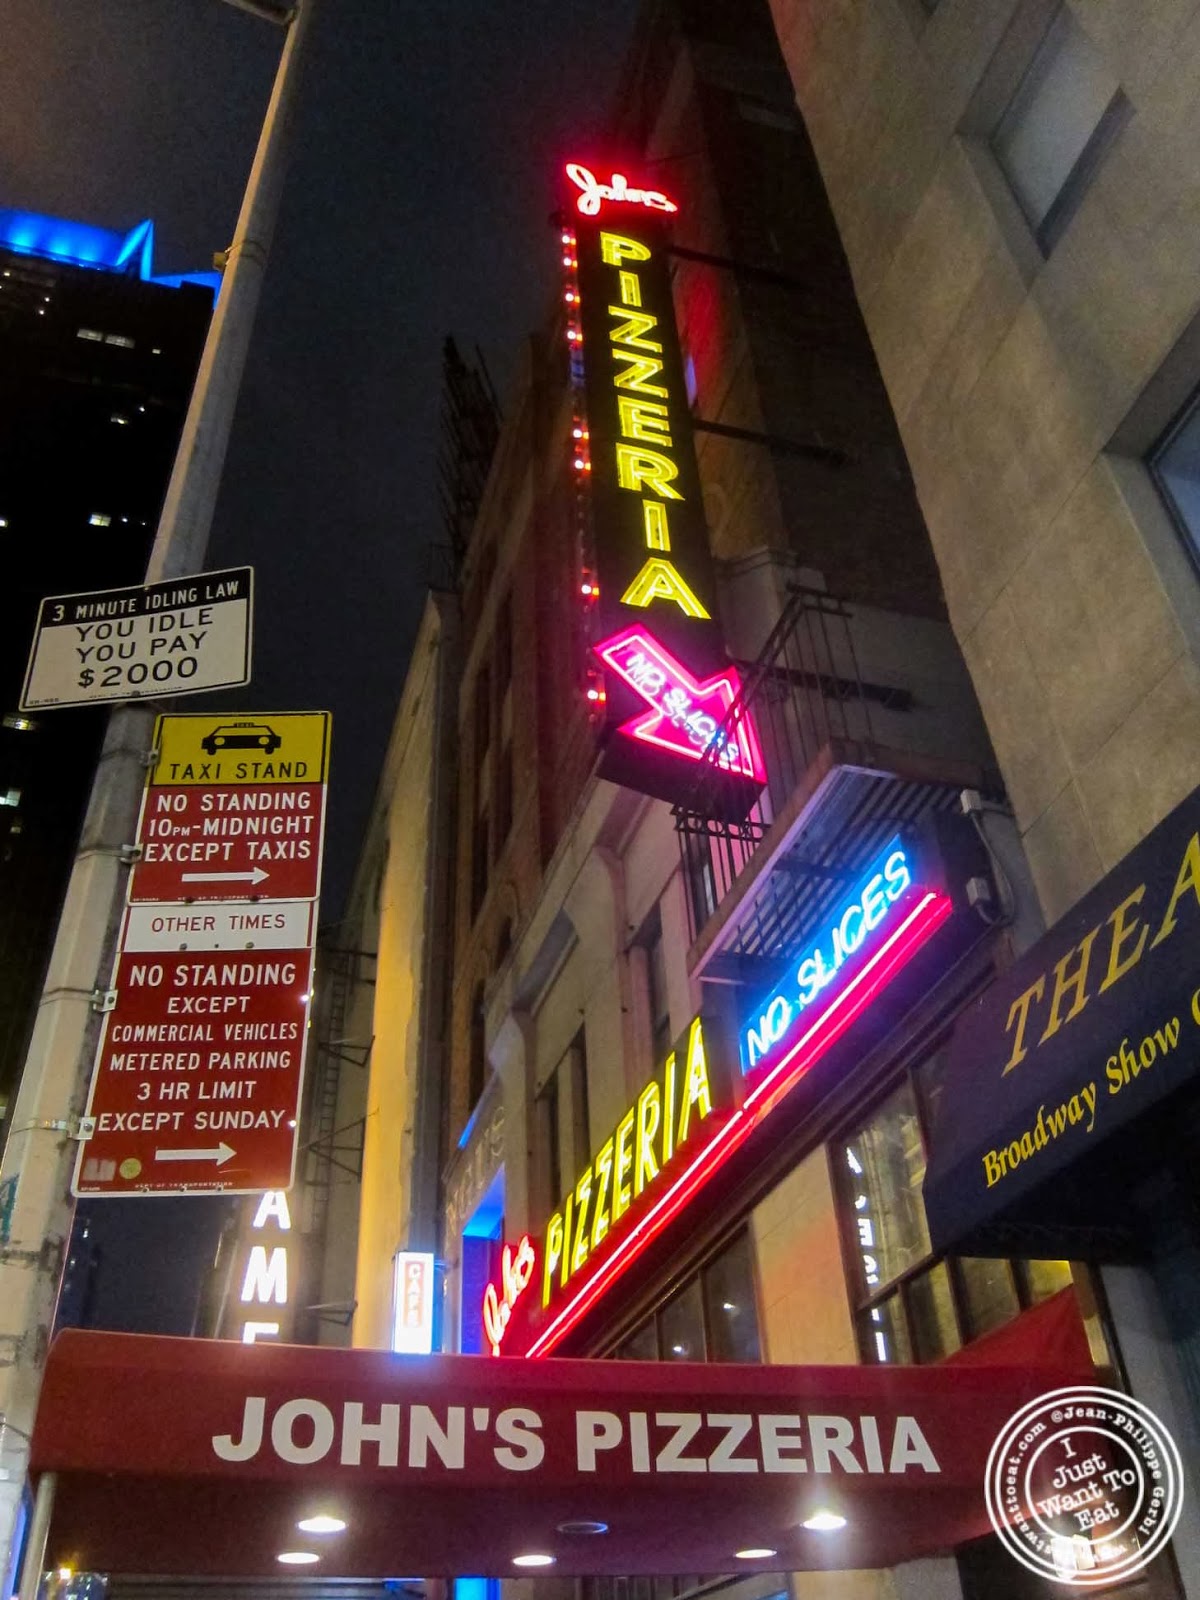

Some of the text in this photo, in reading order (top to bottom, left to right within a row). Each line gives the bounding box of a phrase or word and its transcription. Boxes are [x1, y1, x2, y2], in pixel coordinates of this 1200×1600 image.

[600, 231, 712, 620] PIZZERIA
[52, 580, 239, 621] 3 MINUTE IDLING LAW
[76, 607, 213, 642] YOU IDLE
[76, 631, 207, 664] YOU PAY
[77, 656, 198, 689] $2000
[170, 762, 307, 779] TAXI STAND
[157, 792, 311, 812] NO STANDING
[144, 840, 311, 862] EXCEPT TAXIS
[151, 914, 286, 932] OTHER TIMES
[747, 851, 911, 1066] NO SLICES
[129, 963, 296, 987] NO STANDING
[167, 996, 250, 1013] EXCEPT
[112, 1023, 298, 1042] COMMERCIAL VEHICLES
[110, 1051, 291, 1071] METERED PARKING
[137, 1081, 257, 1100] 3 HR LIMIT
[982, 1016, 1180, 1188] Broadway Show
[98, 1110, 285, 1131] EXCEPT SUNDAY
[542, 1016, 712, 1310] PIZZERIA
[211, 1397, 941, 1474] JOHN'S PIZZERIA
